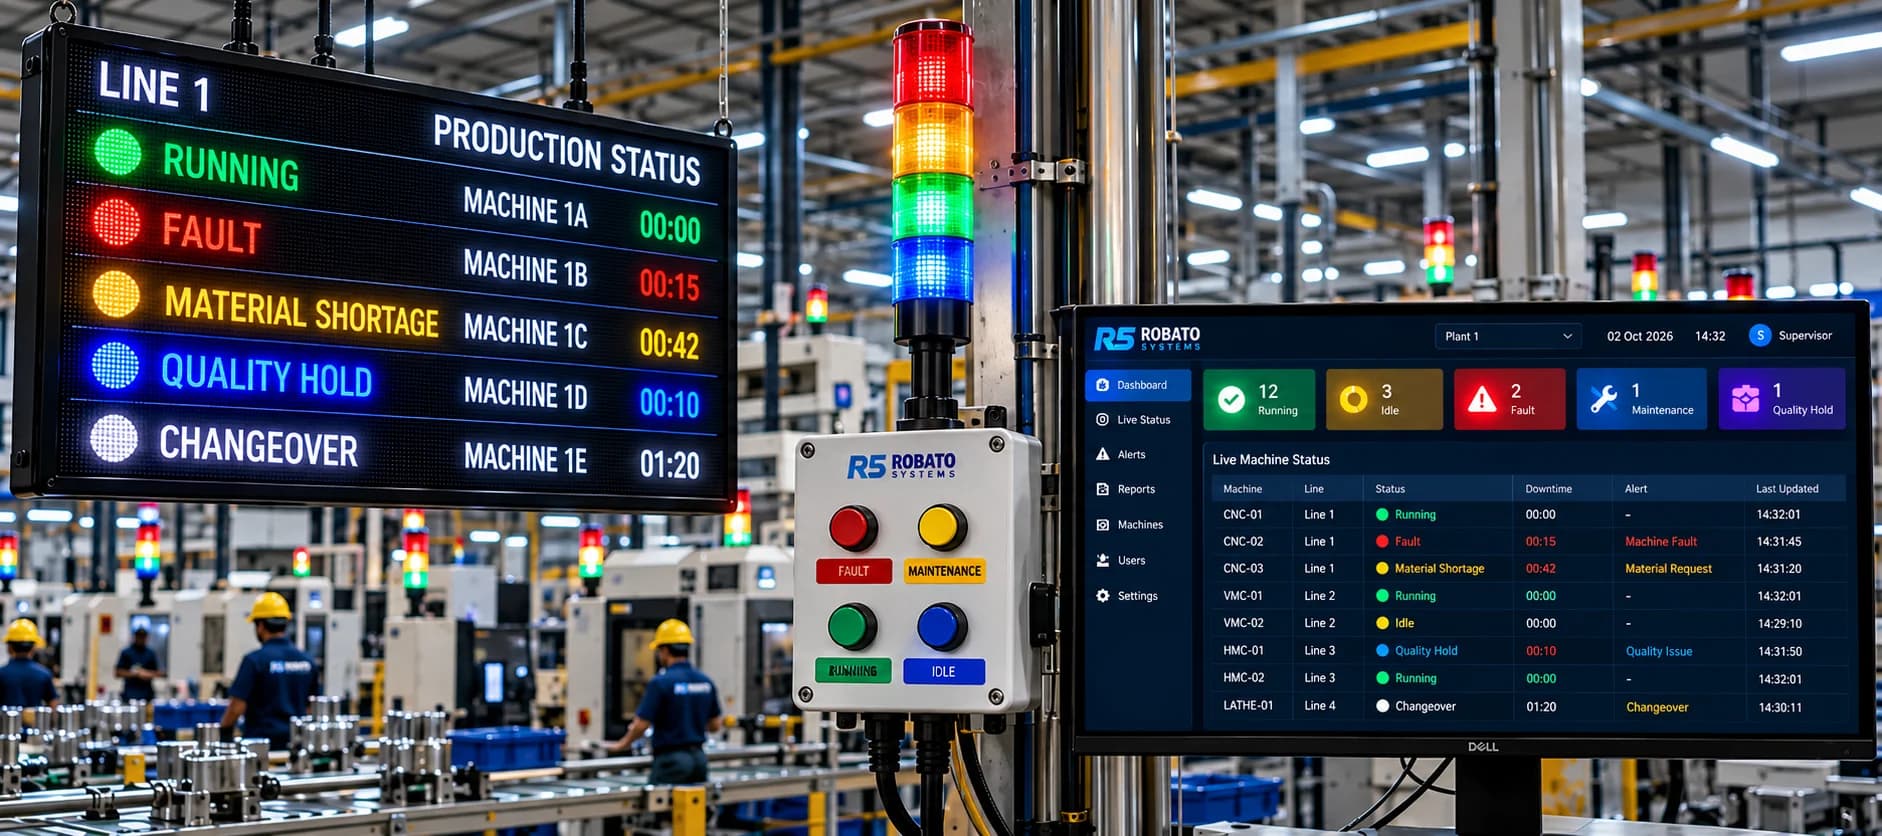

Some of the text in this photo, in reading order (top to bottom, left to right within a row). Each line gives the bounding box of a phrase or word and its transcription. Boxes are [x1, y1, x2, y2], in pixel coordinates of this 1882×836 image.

[100, 61, 207, 112] LINE 1
[433, 113, 700, 186] PRODUCTION STATUS
[165, 143, 298, 191] RUNNING
[465, 186, 588, 228] MACHINE 1A
[164, 212, 261, 254] FAULT
[641, 210, 700, 244] 00:00
[465, 249, 587, 287] MACHINE 1B
[641, 269, 699, 301] 00:15
[166, 285, 438, 337] MATERIAL SHORTAGE
[465, 313, 587, 349] MACHINE 1C
[1141, 326, 1201, 342] ROBATO
[1445, 331, 1479, 342] Plant 1
[1607, 330, 1674, 342] 02 Oct 2026
[1695, 330, 1726, 342] 14:32
[1757, 329, 1765, 341] S
[1779, 330, 1833, 343] Supervisor
[641, 328, 698, 360] 00:42
[1141, 342, 1201, 352] SYSTEMS
[162, 353, 371, 397] QUALITY HOLD
[1117, 379, 1168, 390] Dashboard
[1631, 382, 1639, 398] 1
[1773, 382, 1781, 398] 1
[465, 377, 587, 409] MACHINE 1D
[1259, 383, 1279, 399] 12
[1382, 383, 1392, 399] 3
[1511, 383, 1522, 399] 2
[641, 388, 699, 418] 00:10
[1258, 405, 1298, 418] Running
[1381, 405, 1400, 416] Idle
[1511, 404, 1536, 415] Fault
[1632, 405, 1695, 415] Maintenance
[1772, 404, 1834, 417] Quality Hold
[1117, 414, 1171, 425] Live Status
[160, 425, 358, 467] CHANGEOVER
[465, 442, 587, 473] MACHINE 1E
[1117, 449, 1146, 459] Alerts
[1212, 453, 1331, 466] Live Machine Status
[641, 450, 699, 479] 01:20
[891, 452, 956, 470] ROBATO
[891, 469, 956, 479] SYSTEMS
[1118, 484, 1156, 496] Reports
[1223, 484, 1263, 494] Machine
[1304, 483, 1325, 494] Line
[1375, 483, 1406, 494] Status
[1525, 483, 1573, 494] Downtime
[1624, 483, 1648, 494] Alert
[1756, 483, 1819, 496] Last Updated
[1223, 508, 1262, 520] CNC-01
[1304, 509, 1334, 520] Line 1
[1395, 508, 1437, 522] Running
[1525, 508, 1556, 520] 00:00
[1757, 508, 1800, 520] 14:32:01
[1118, 519, 1164, 530] Machines
[1223, 535, 1264, 547] CNC-02
[1304, 535, 1334, 547] Line 1
[1395, 535, 1422, 547] Fault
[1525, 535, 1557, 547] 00:15
[1625, 535, 1698, 547] Machine Fault
[1757, 535, 1802, 547] 14:31:45
[1118, 555, 1146, 566] Users
[838, 565, 870, 577] FAULT
[908, 565, 982, 577] MAINTENANCE
[1223, 562, 1264, 574] CNC-03
[1304, 563, 1334, 574] Line 1
[1395, 562, 1485, 576] Material Shortage
[1525, 563, 1556, 574] 00:42
[1625, 562, 1713, 577] Material Request
[1757, 563, 1802, 574] 14:31:20
[1118, 590, 1159, 603] Settings
[1223, 590, 1262, 601] VMC-01
[1304, 590, 1336, 601] Line 2
[1395, 590, 1437, 604] Running
[1526, 590, 1557, 601] 00:00
[1758, 590, 1801, 602] 14:32:01
[1223, 617, 1264, 628] VMC-02
[1304, 617, 1336, 629] Line 2
[1395, 617, 1415, 629] Idle
[1526, 617, 1557, 629] 00:00
[1758, 618, 1803, 629] 14:29:10
[1223, 644, 1264, 656] HMC-01
[1304, 645, 1336, 656] Line 3
[1395, 645, 1458, 658] Quality Hold
[1526, 645, 1557, 656] 00:10
[1626, 645, 1694, 659] Quality Issue
[1758, 646, 1803, 657] 14:31:50
[932, 665, 956, 678] IDLE
[1223, 671, 1265, 683] HMC-02
[1304, 672, 1336, 683] Line 3
[1395, 672, 1437, 686] Running
[1526, 673, 1557, 684] 00:00
[1758, 673, 1802, 685] 14:32:01
[1223, 699, 1273, 711] LATHE-01
[1304, 700, 1337, 711] Line 4
[1395, 700, 1457, 714] Changeover
[1526, 701, 1557, 713] 01:20
[1626, 701, 1689, 715] Changeover
[1759, 702, 1802, 713] 14:30:11
[1468, 741, 1500, 752] DELL
